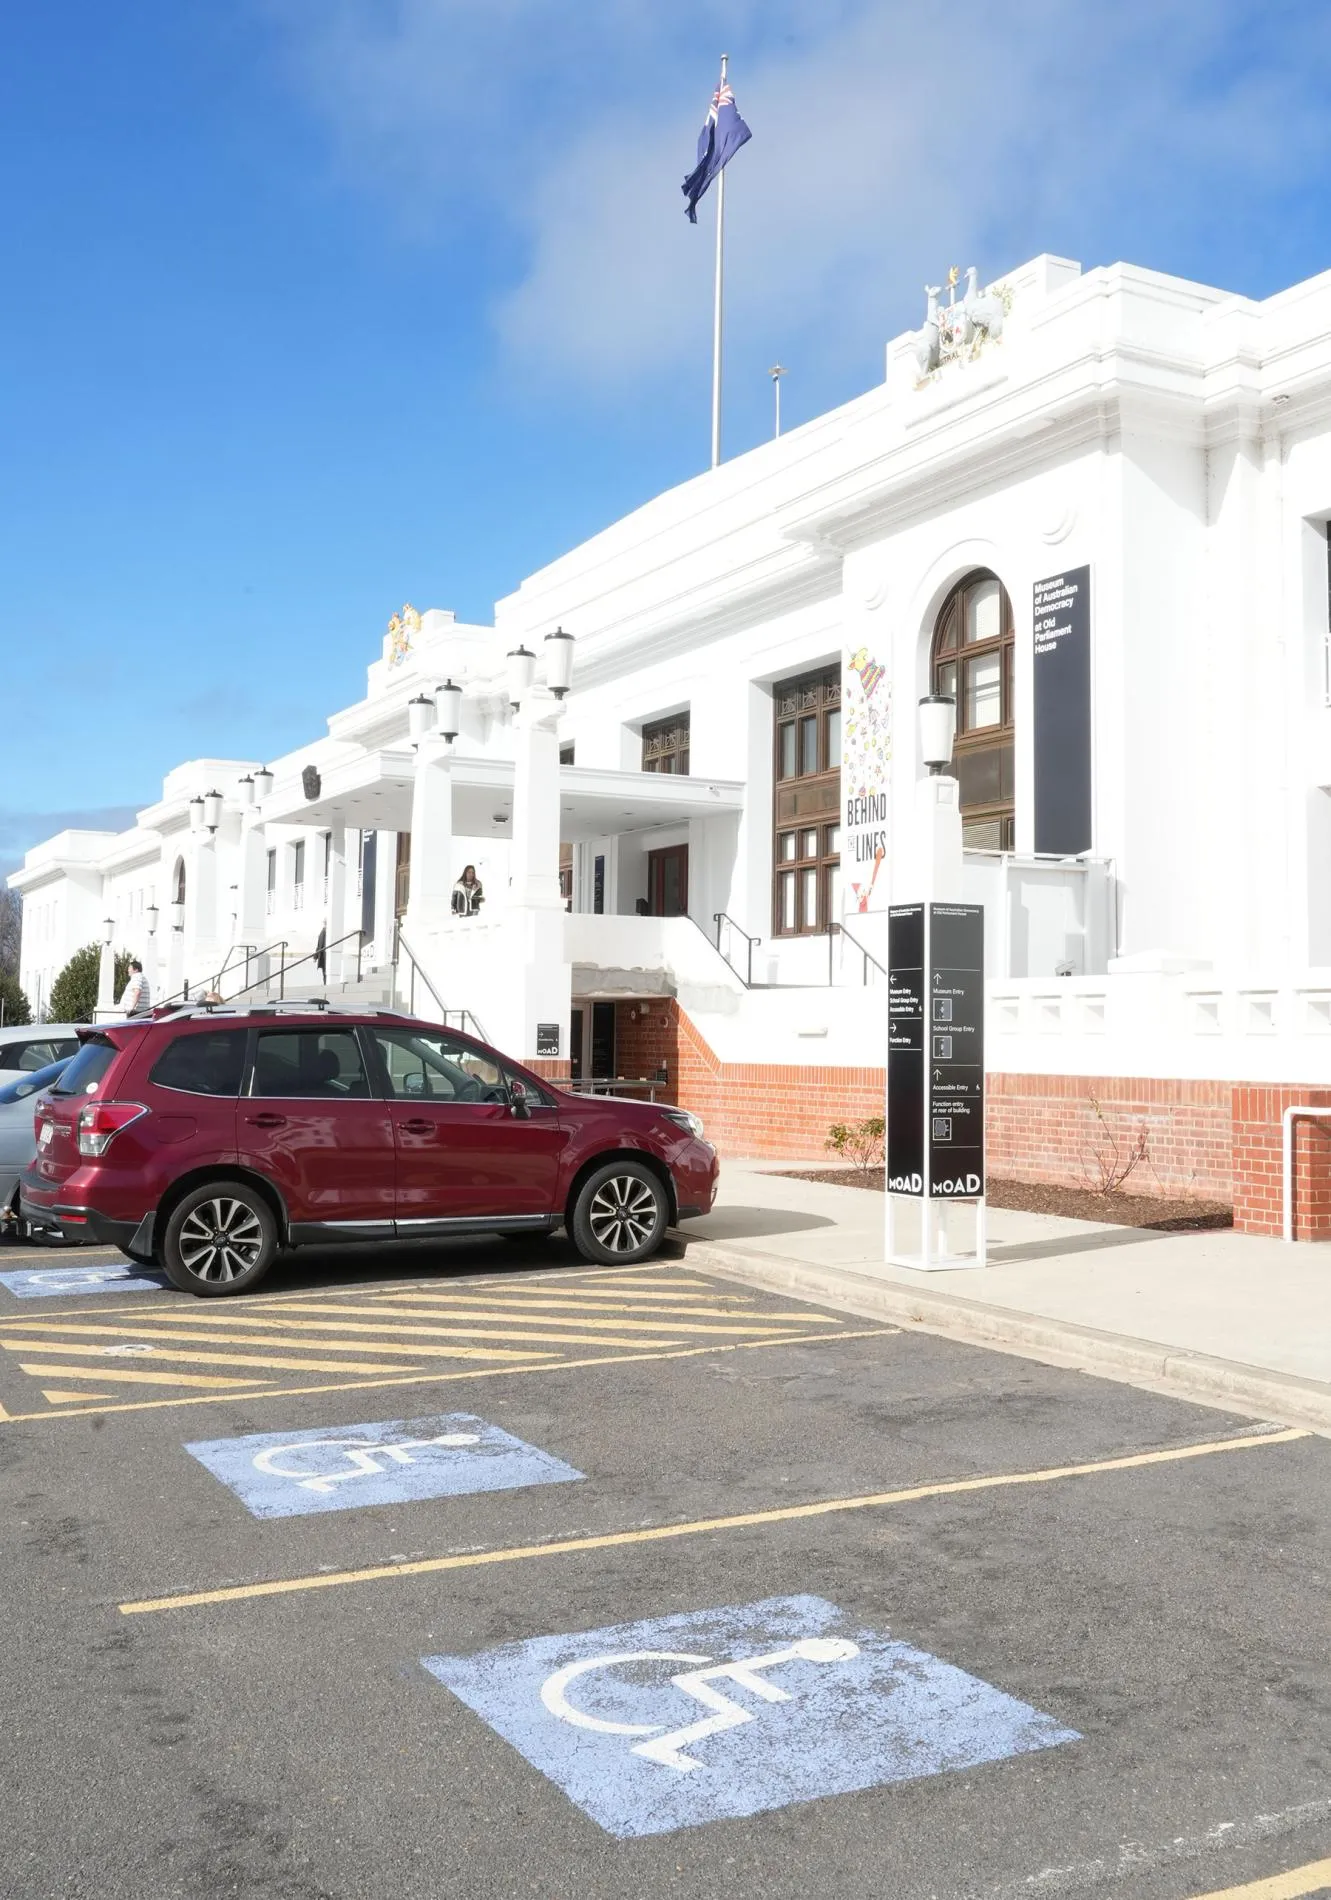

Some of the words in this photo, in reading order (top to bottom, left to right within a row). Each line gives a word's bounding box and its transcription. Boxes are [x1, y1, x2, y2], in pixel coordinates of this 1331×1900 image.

[1034, 577, 1064, 594] Museum
[1034, 594, 1042, 605] of
[1043, 585, 1078, 602] Australian
[1034, 597, 1074, 616] Democracy
[1034, 622, 1042, 632] at
[1043, 617, 1056, 629] Old
[1034, 624, 1072, 643] Parliament
[1034, 641, 1057, 654] House
[847, 792, 887, 827] BEHIND
[856, 830, 887, 863] LINES
[952, 988, 964, 996] Entry
[889, 1173, 922, 1193] MOAD
[932, 1173, 981, 1194] MOAD
